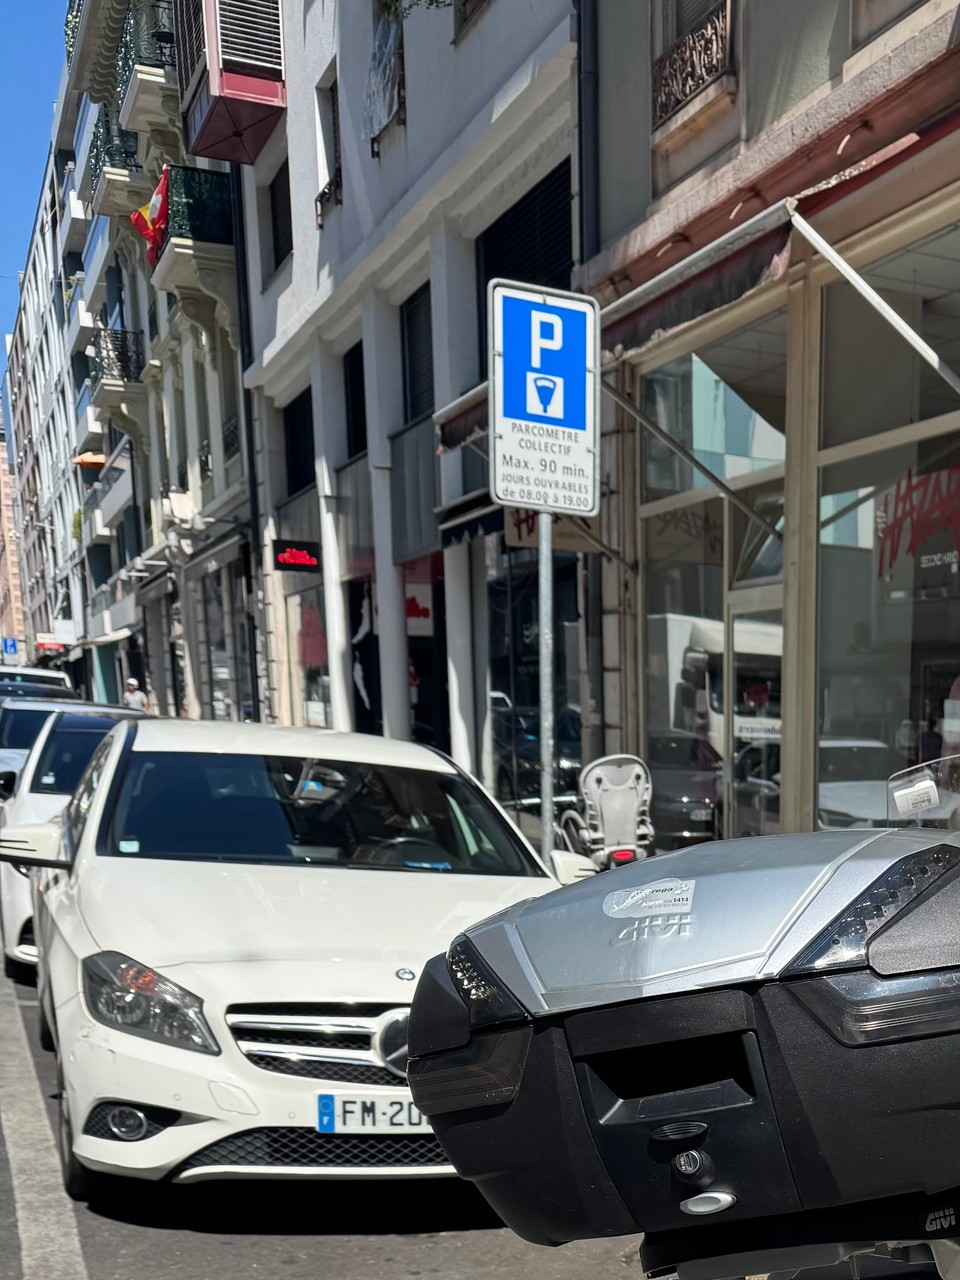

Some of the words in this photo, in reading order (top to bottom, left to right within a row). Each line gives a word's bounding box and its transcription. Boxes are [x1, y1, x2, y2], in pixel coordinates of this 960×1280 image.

[531, 310, 563, 369] P
[518, 438, 571, 455] COLLECTIF
[502, 453, 534, 471] Max.
[540, 458, 557, 473] 90
[562, 464, 589, 478] min.
[502, 473, 530, 486] JOURS
[534, 477, 589, 494] OUVRABLES
[502, 486, 515, 497] de
[342, 1101, 431, 1126] FM-20
[925, 1208, 956, 1231] GIVI
